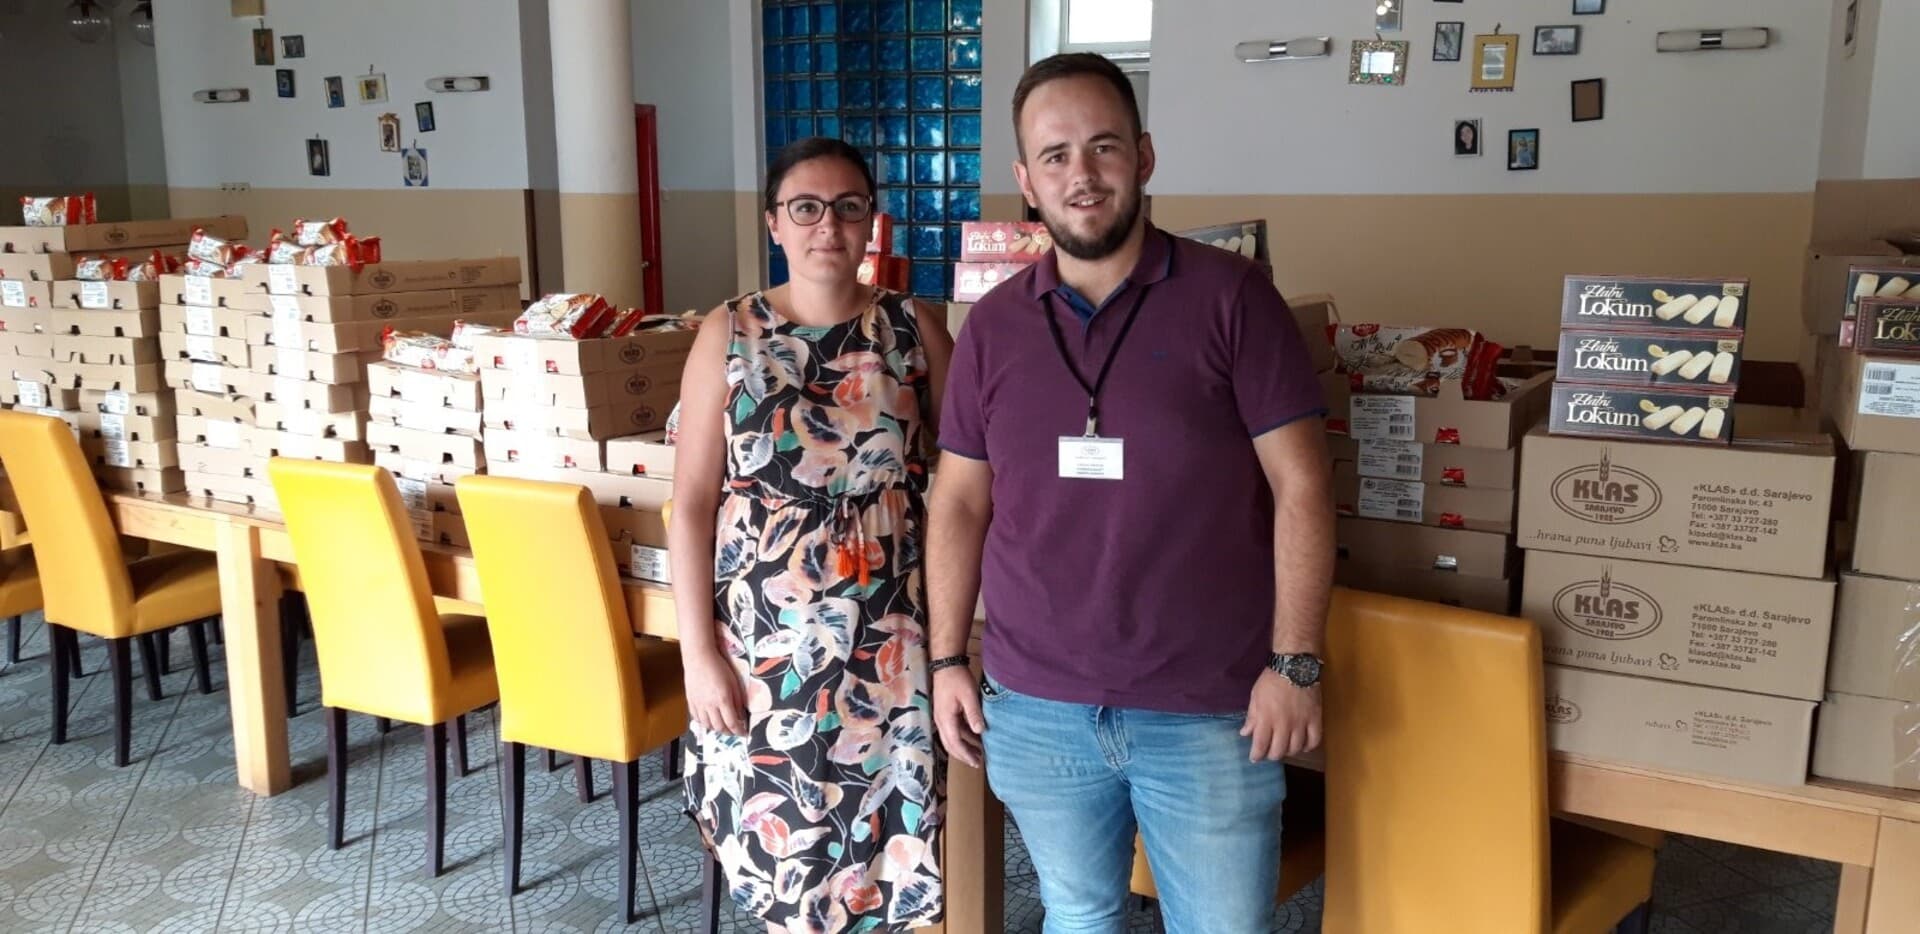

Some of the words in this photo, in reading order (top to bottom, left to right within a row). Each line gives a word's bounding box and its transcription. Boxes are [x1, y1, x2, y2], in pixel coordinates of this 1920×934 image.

[1578, 294, 1653, 318] Lokum
[1873, 318, 1920, 341] Lok
[1574, 348, 1648, 372] Lokum
[1566, 402, 1640, 427] Lokum
[1572, 479, 1639, 503] KLAS
[1740, 488, 1760, 497] d.d.
[1763, 488, 1813, 502] Sarajevo
[1584, 503, 1625, 514] SARAJEVO
[1720, 505, 1759, 516] Sarajevo
[1575, 535, 1606, 546] puna
[1609, 535, 1652, 551] ljubavi
[1574, 594, 1640, 620] KLAS
[1585, 618, 1626, 630] SARAJEVO
[1739, 609, 1760, 619] d.d.
[1762, 611, 1812, 624] Sarajevo
[1720, 625, 1759, 637] Sarajevo
[1575, 648, 1607, 660] puna
[1610, 650, 1653, 667] ljubavi
